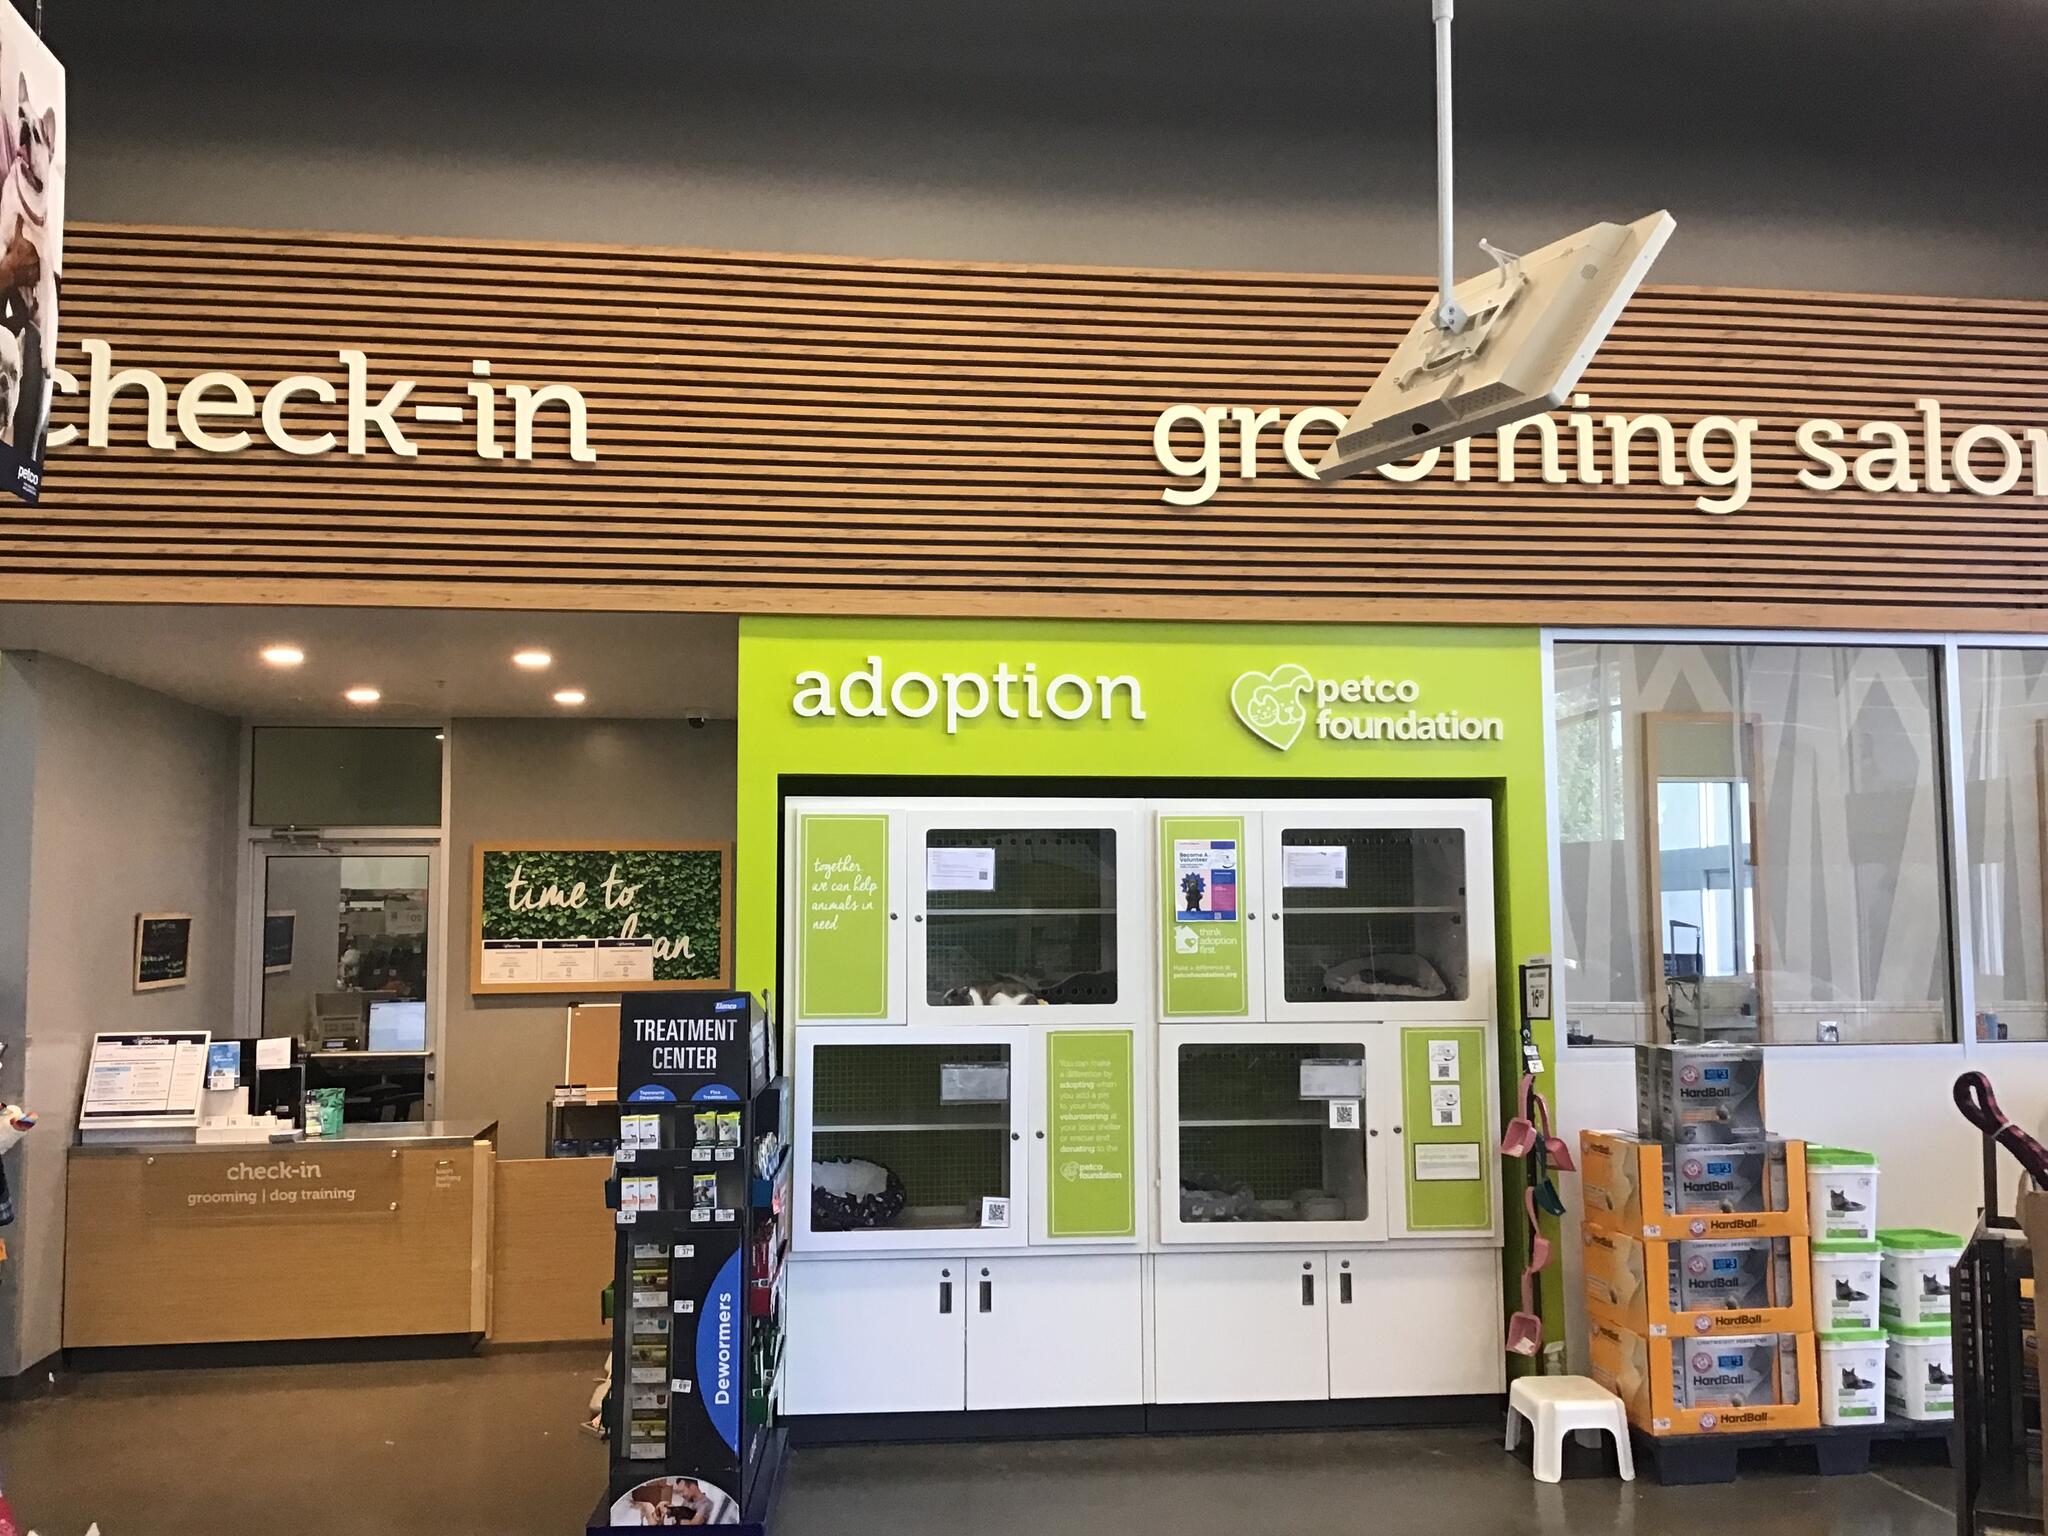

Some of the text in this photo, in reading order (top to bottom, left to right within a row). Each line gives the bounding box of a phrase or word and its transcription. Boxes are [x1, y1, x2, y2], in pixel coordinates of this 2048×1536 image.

[17, 465, 39, 485] petco
[792, 655, 1147, 735] adoption
[1317, 675, 1420, 709] petco
[1316, 708, 1504, 740] foundation
[813, 854, 862, 880] together
[505, 863, 644, 911] time to
[811, 874, 878, 896] we can help
[811, 895, 873, 911] animals in
[812, 914, 839, 930] need
[1199, 927, 1222, 937] think
[1199, 936, 1238, 948] adoption
[633, 1019, 738, 1042] TREATMENT
[652, 1047, 718, 1069] CENTER
[1680, 1087, 1731, 1098] HardBall
[226, 1161, 322, 1181] check-in
[187, 1191, 257, 1207] grooming
[270, 1187, 297, 1203] dog
[301, 1186, 356, 1201] training
[1684, 1181, 1734, 1192] HardBall
[1710, 1219, 1758, 1229] HardBall
[1689, 1277, 1739, 1288] HardBall
[1715, 1315, 1762, 1325] HardBall
[714, 1292, 732, 1406] Dewormers
[1694, 1374, 1744, 1386] HardBall
[1720, 1412, 1768, 1423] HardBall
